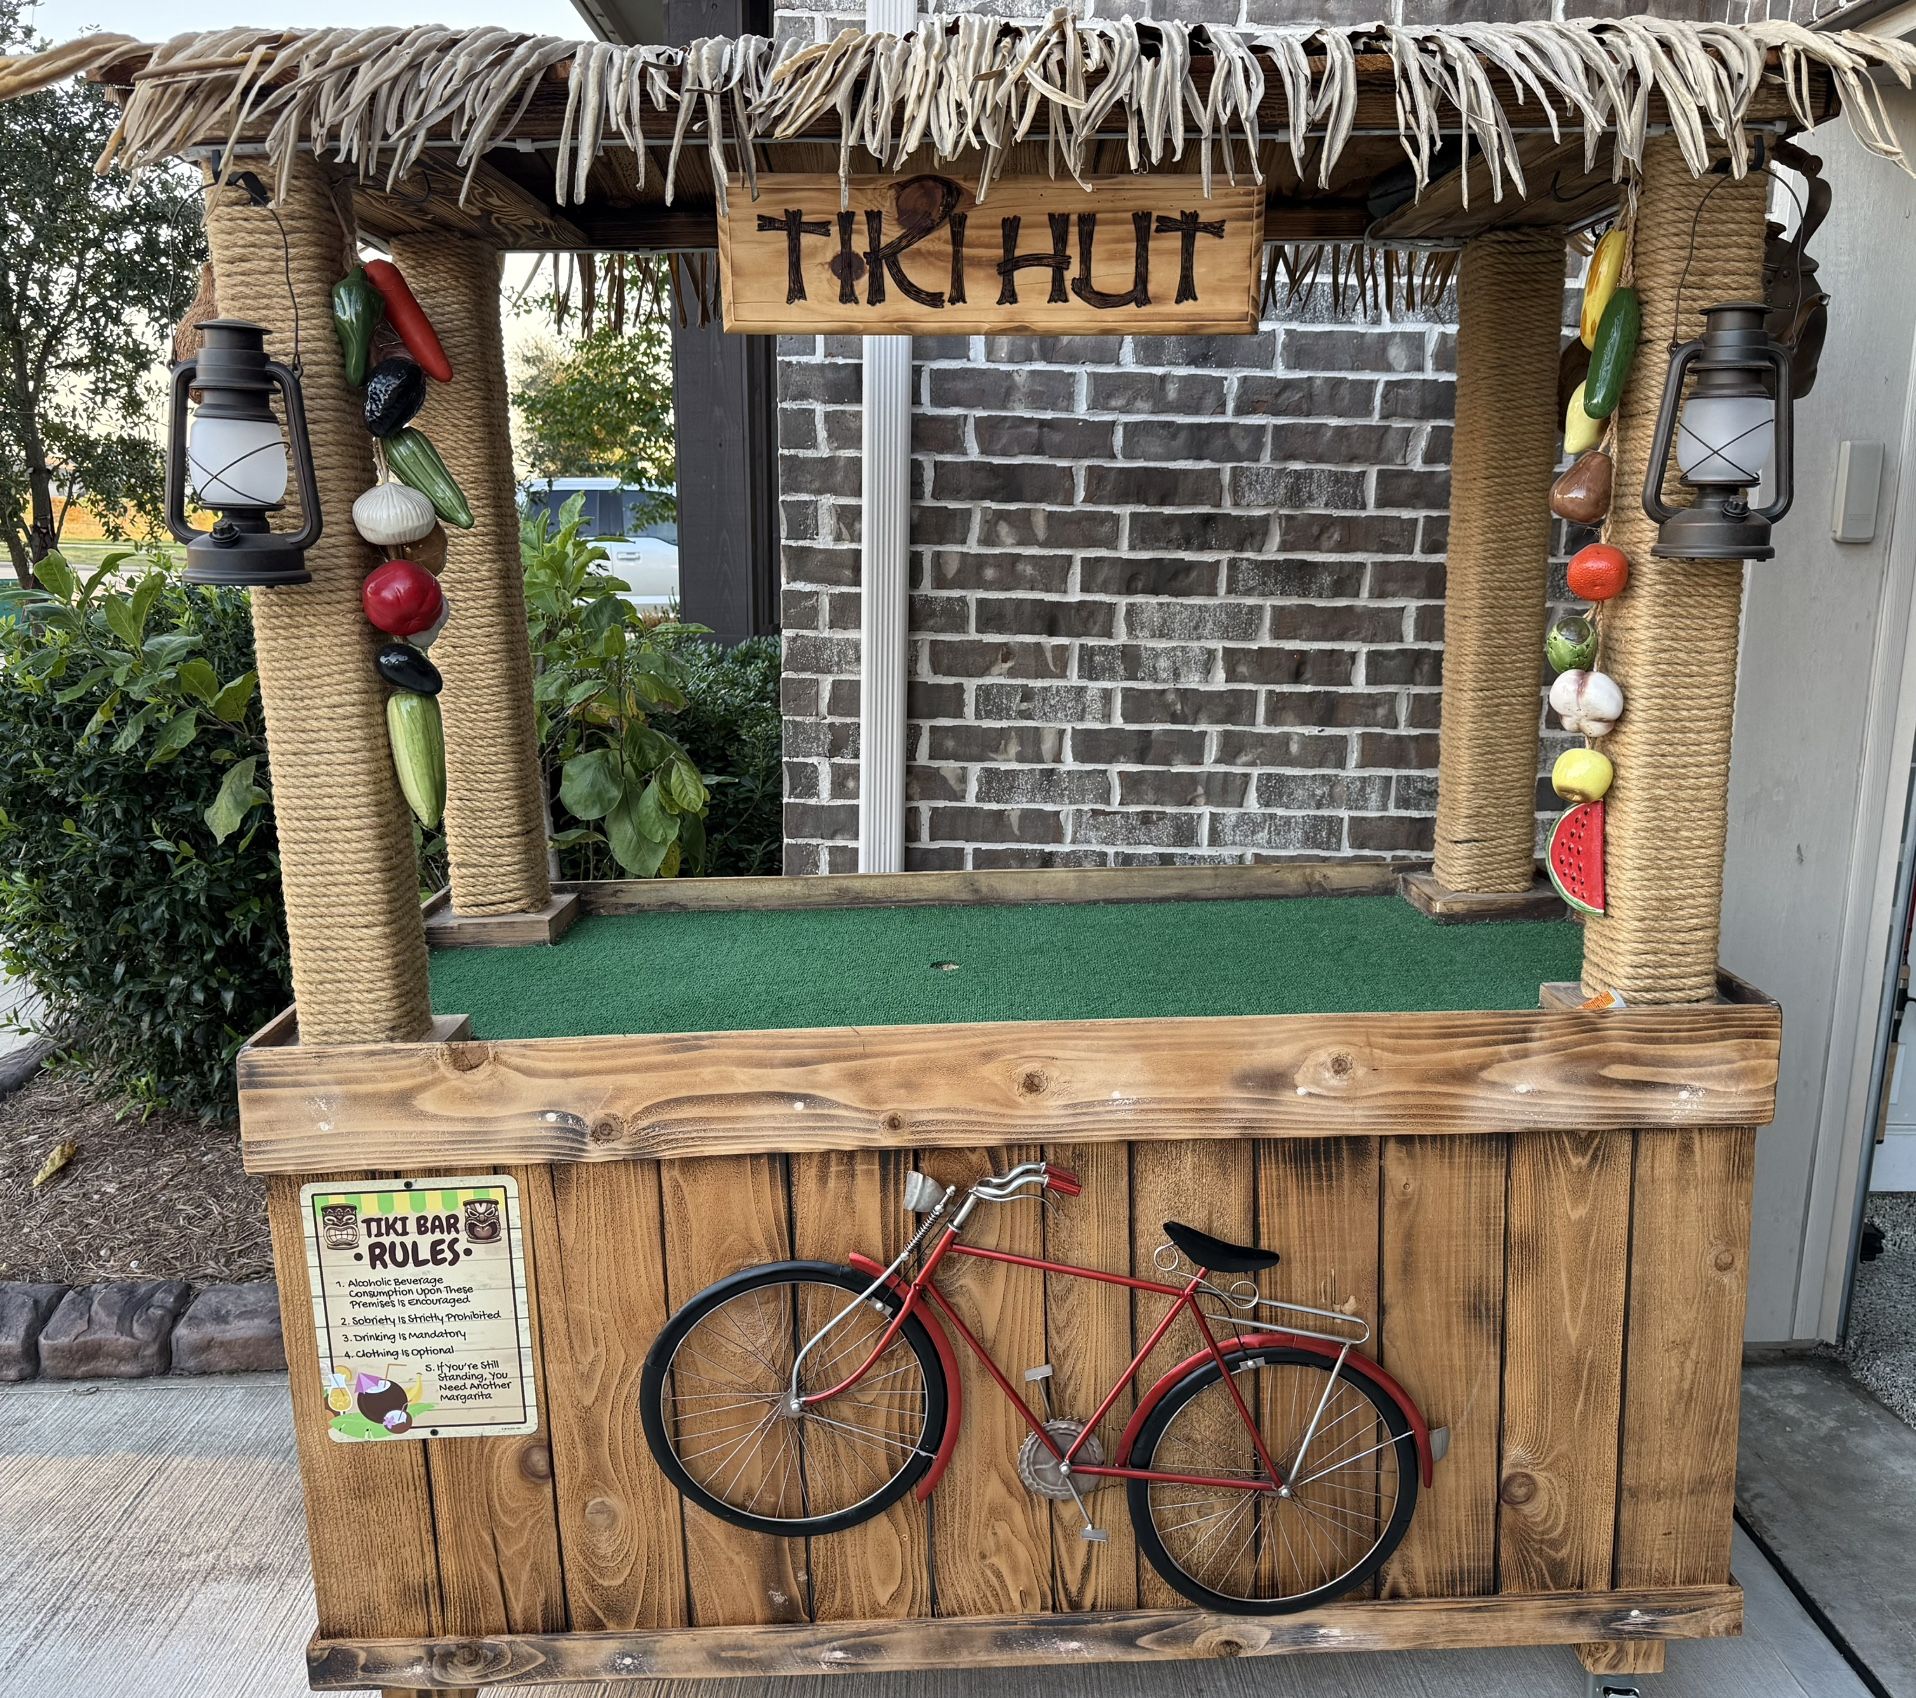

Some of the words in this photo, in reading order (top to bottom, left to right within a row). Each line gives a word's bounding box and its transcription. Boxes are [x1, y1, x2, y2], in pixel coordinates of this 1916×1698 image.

[756, 184, 967, 309] TIKI
[997, 209, 1226, 308] HUT
[361, 1216, 409, 1238] TIKI
[416, 1214, 460, 1235] BAR
[368, 1237, 460, 1270] RULES
[348, 1278, 392, 1288] Alcoholic
[393, 1277, 444, 1288] Beverage
[349, 1287, 414, 1299] Consumption
[416, 1287, 442, 1298] Upon
[444, 1285, 474, 1294] These
[350, 1299, 396, 1309] Premises
[398, 1299, 406, 1307] Is
[408, 1295, 471, 1307] Encouraged
[341, 1317, 351, 1326] 2.
[352, 1316, 396, 1327] Sobriety
[398, 1316, 406, 1325] Is
[408, 1313, 444, 1325] Strictly
[445, 1310, 501, 1322] Prohibited
[343, 1334, 352, 1342] 3.
[353, 1332, 396, 1343] Drinking
[399, 1332, 407, 1341] Is
[408, 1330, 466, 1341] Mandatory
[344, 1351, 354, 1359] 4.
[355, 1348, 398, 1360] Clothing
[401, 1348, 410, 1357] Is
[411, 1346, 454, 1360] Optional
[425, 1364, 435, 1372] 5.
[480, 1360, 500, 1370] Still
[438, 1371, 487, 1384] Standing,
[489, 1371, 508, 1381] You
[439, 1382, 468, 1391] Need
[469, 1380, 512, 1391] Another
[440, 1391, 492, 1404] Margarita
